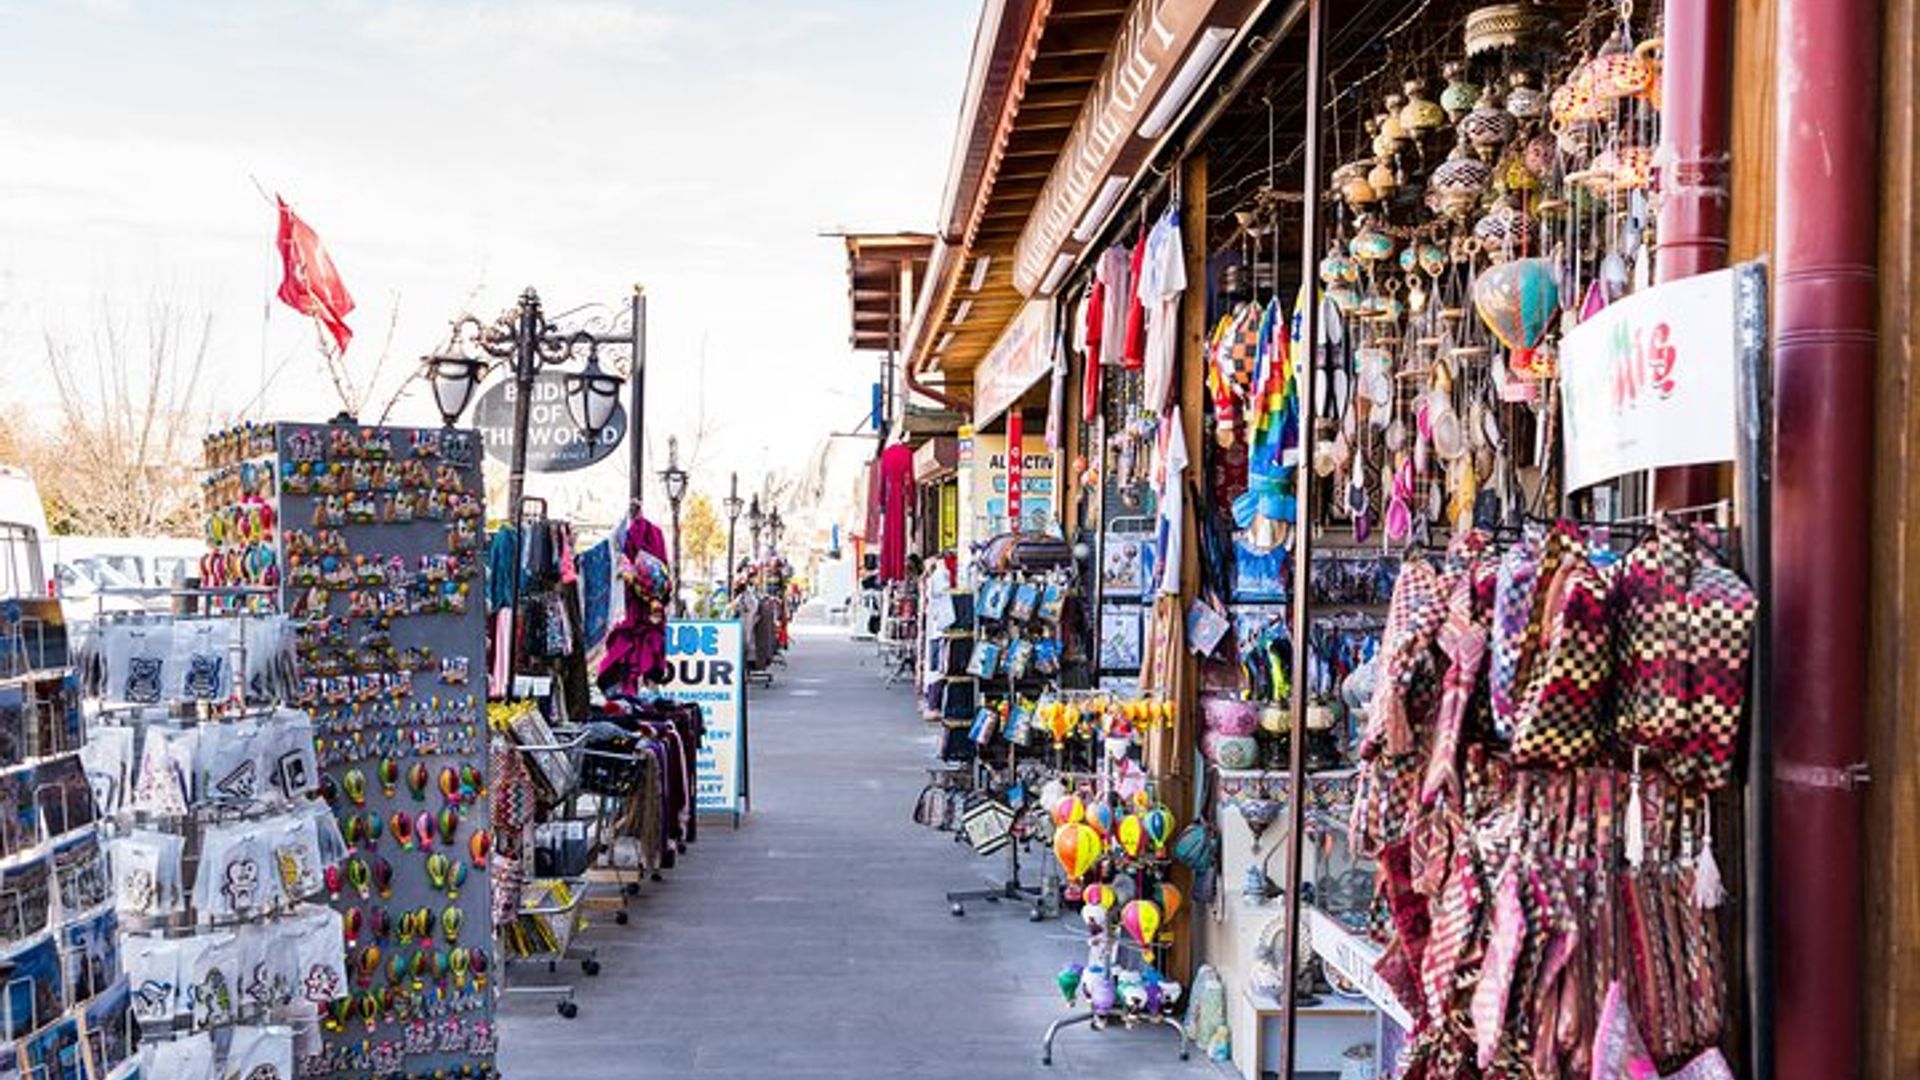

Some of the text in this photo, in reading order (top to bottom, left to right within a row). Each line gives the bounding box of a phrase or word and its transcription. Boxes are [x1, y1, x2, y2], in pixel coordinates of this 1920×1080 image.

[532, 404, 562, 424] OF
[527, 425, 618, 446] WORD
[666, 625, 719, 656] LUE
